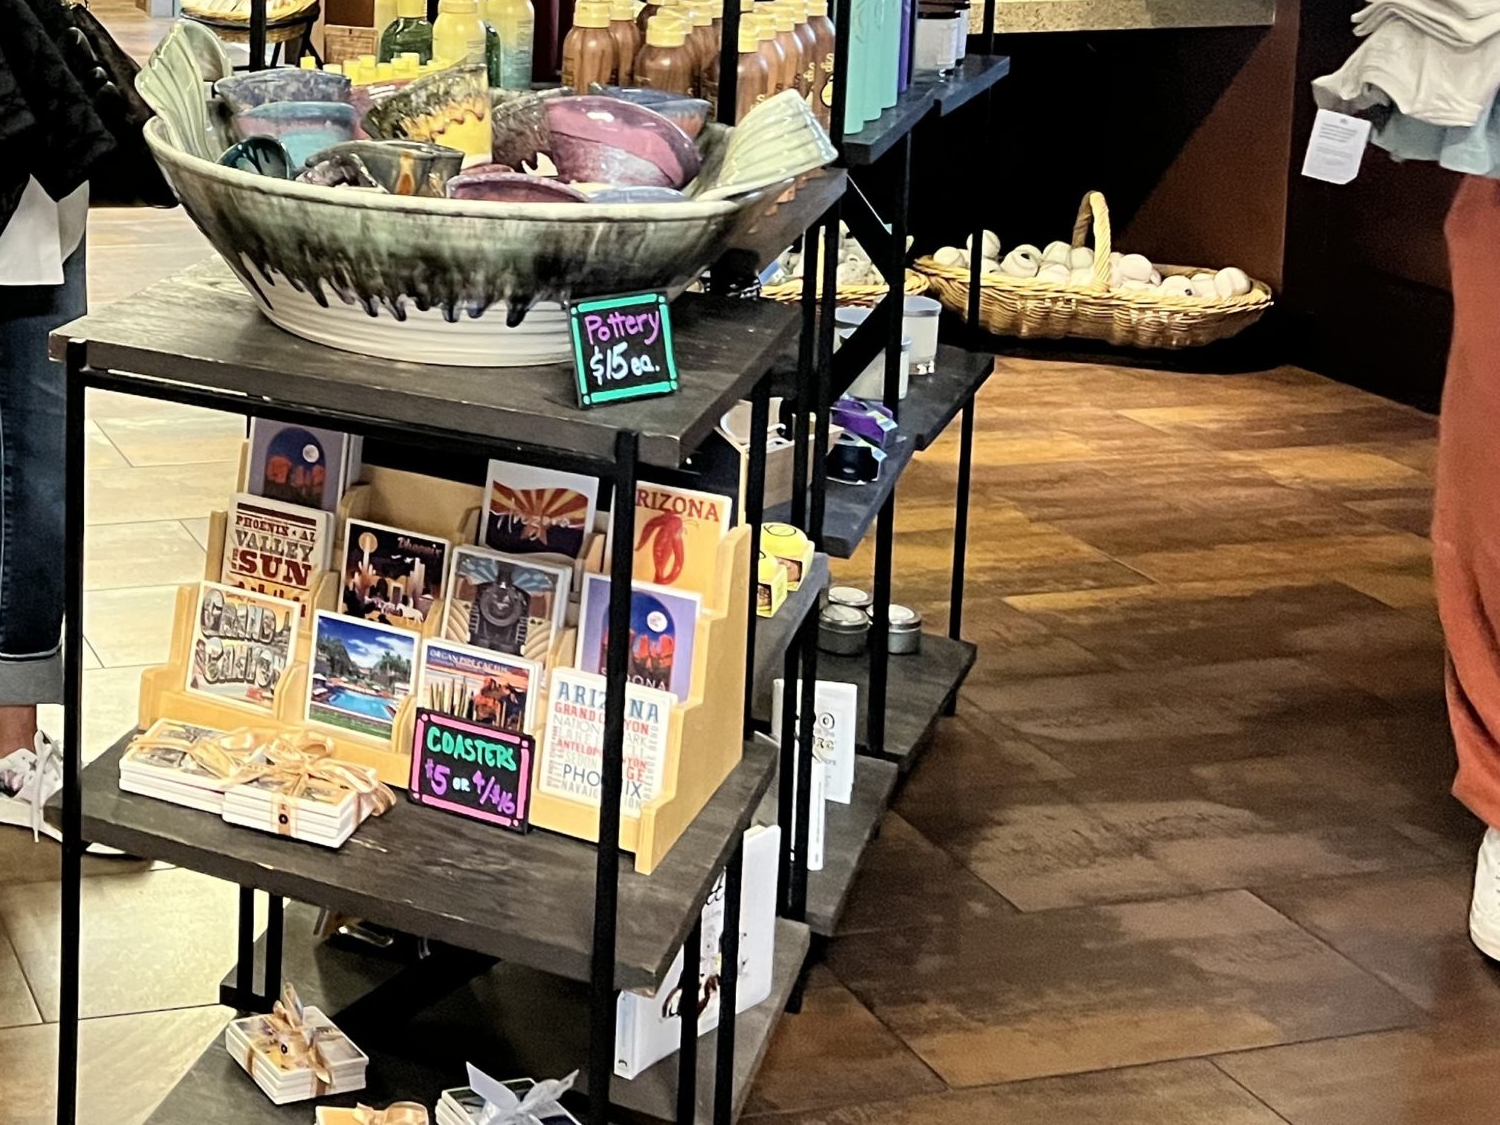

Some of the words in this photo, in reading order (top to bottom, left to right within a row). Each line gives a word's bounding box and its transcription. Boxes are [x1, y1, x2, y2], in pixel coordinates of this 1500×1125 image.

[584, 311, 660, 345] Pottery
[590, 341, 628, 385] $15
[631, 354, 660, 376] ea.
[636, 488, 720, 523] RIZONA
[236, 515, 290, 537] PHOENIX
[235, 529, 314, 563] VALLEY
[238, 549, 312, 586] SUN
[201, 588, 277, 645] GRAND
[429, 649, 458, 663] ORGAN
[555, 701, 596, 722] GRAND
[426, 726, 517, 771] COASTERS
[425, 758, 451, 795] $5
[452, 777, 470, 792] OR
